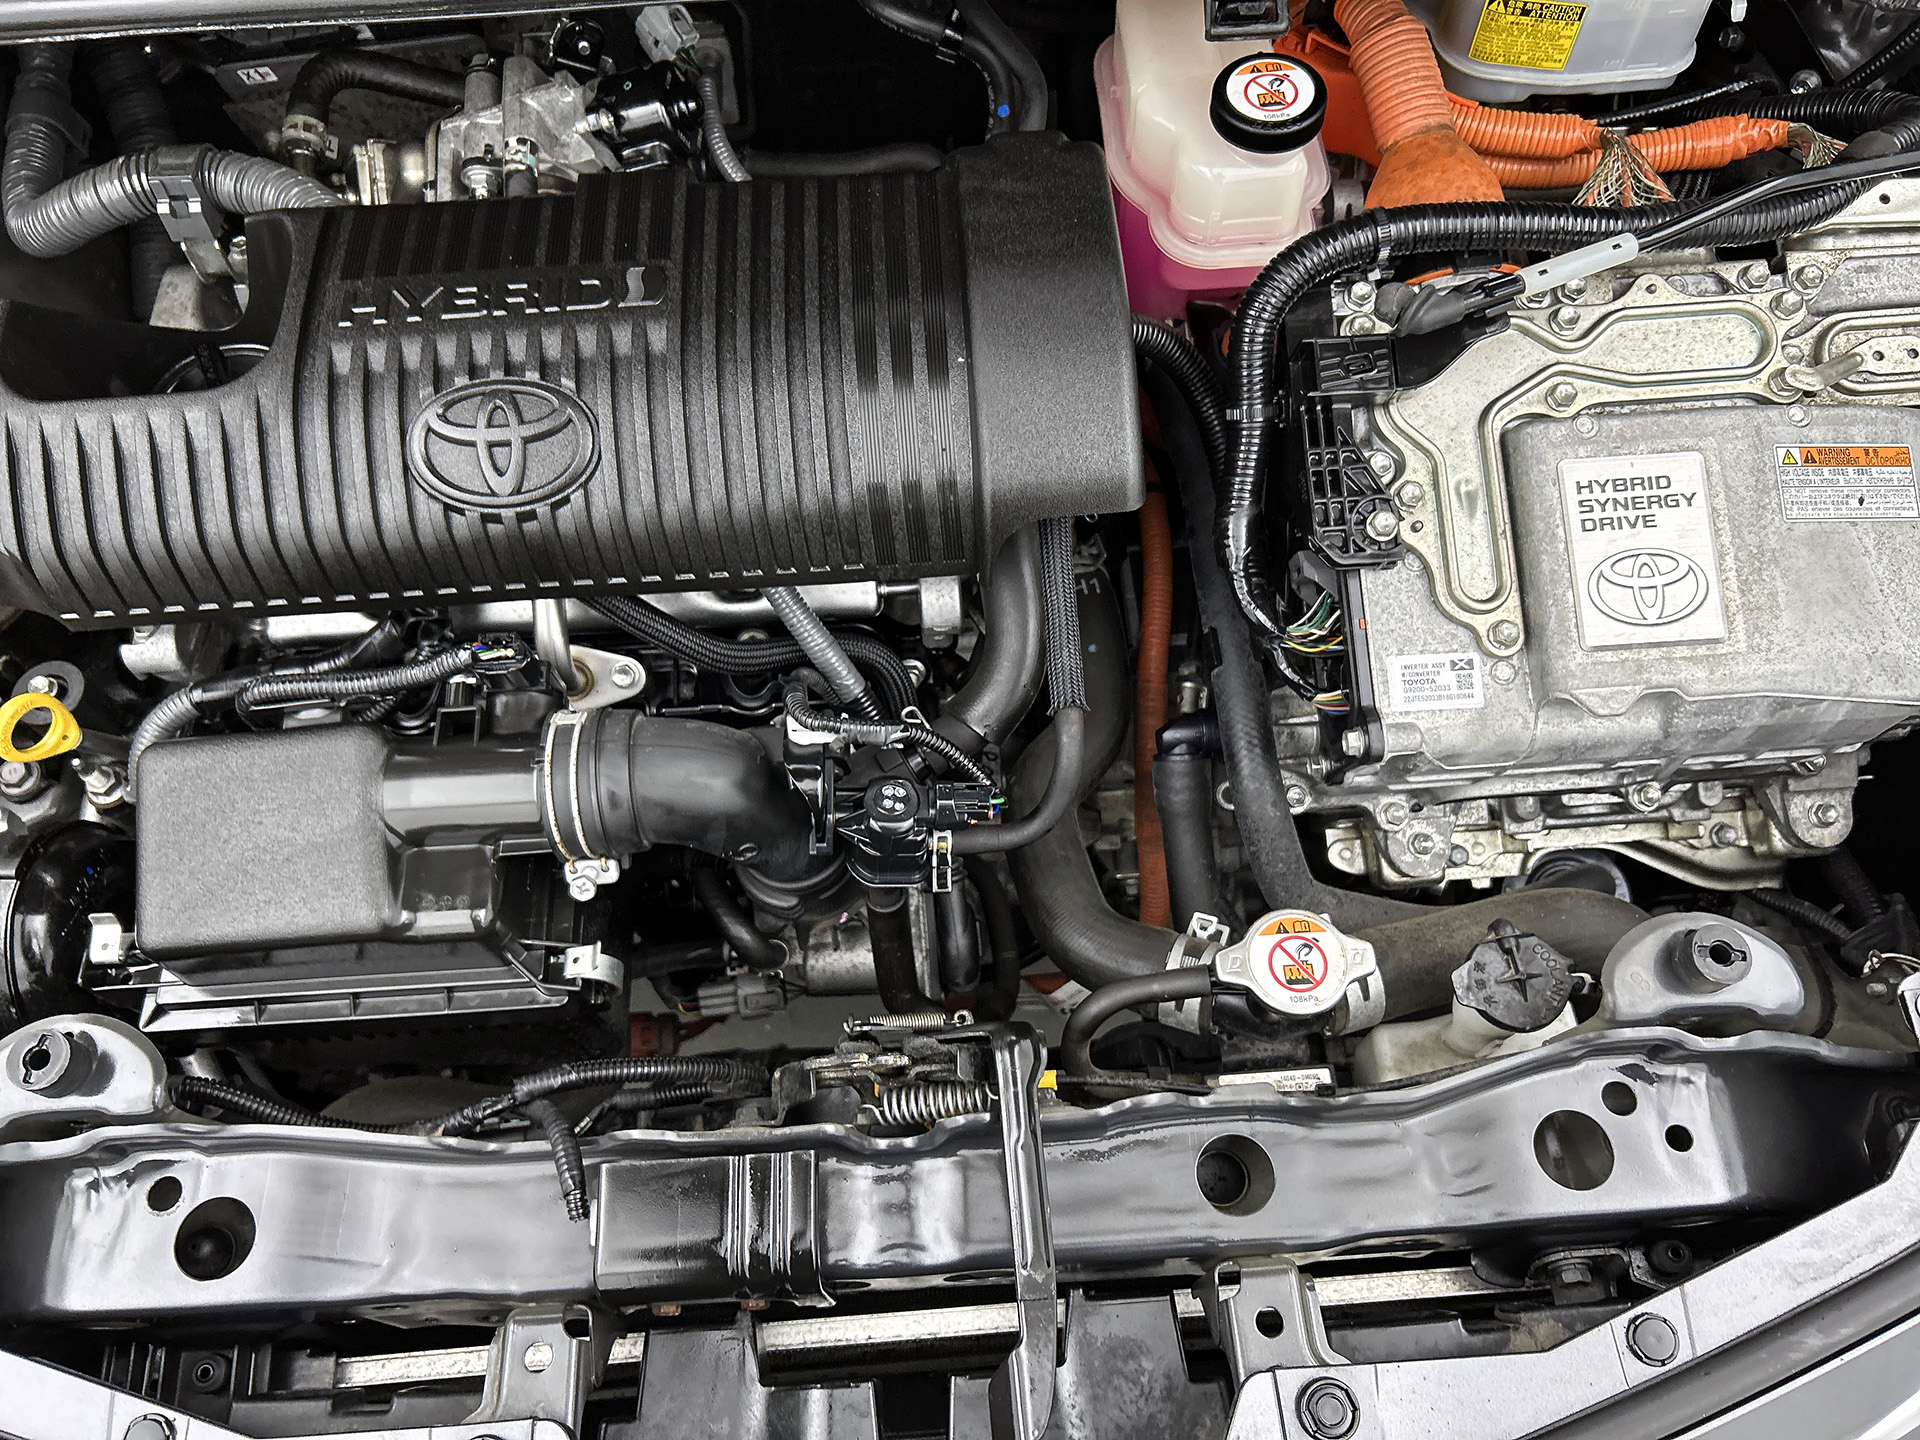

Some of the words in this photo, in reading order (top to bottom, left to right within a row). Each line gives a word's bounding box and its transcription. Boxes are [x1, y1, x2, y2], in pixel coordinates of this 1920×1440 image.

[1543, 4, 1582, 14] CAUTION
[1529, 10, 1580, 21] ATTENTION
[242, 68, 265, 81] X1
[1816, 448, 1851, 457] WARNING
[1818, 457, 1860, 466] AVERTISSEMENT
[1576, 475, 1672, 495] HYBRID
[1578, 492, 1697, 514] SYNERGY
[1580, 514, 1658, 533] DRIVE
[1401, 662, 1428, 671] INVERTER
[1402, 678, 1437, 686] TOYOTA
[1532, 943, 1564, 1006] COOLANT
[1289, 995, 1319, 1003] 108kPa
